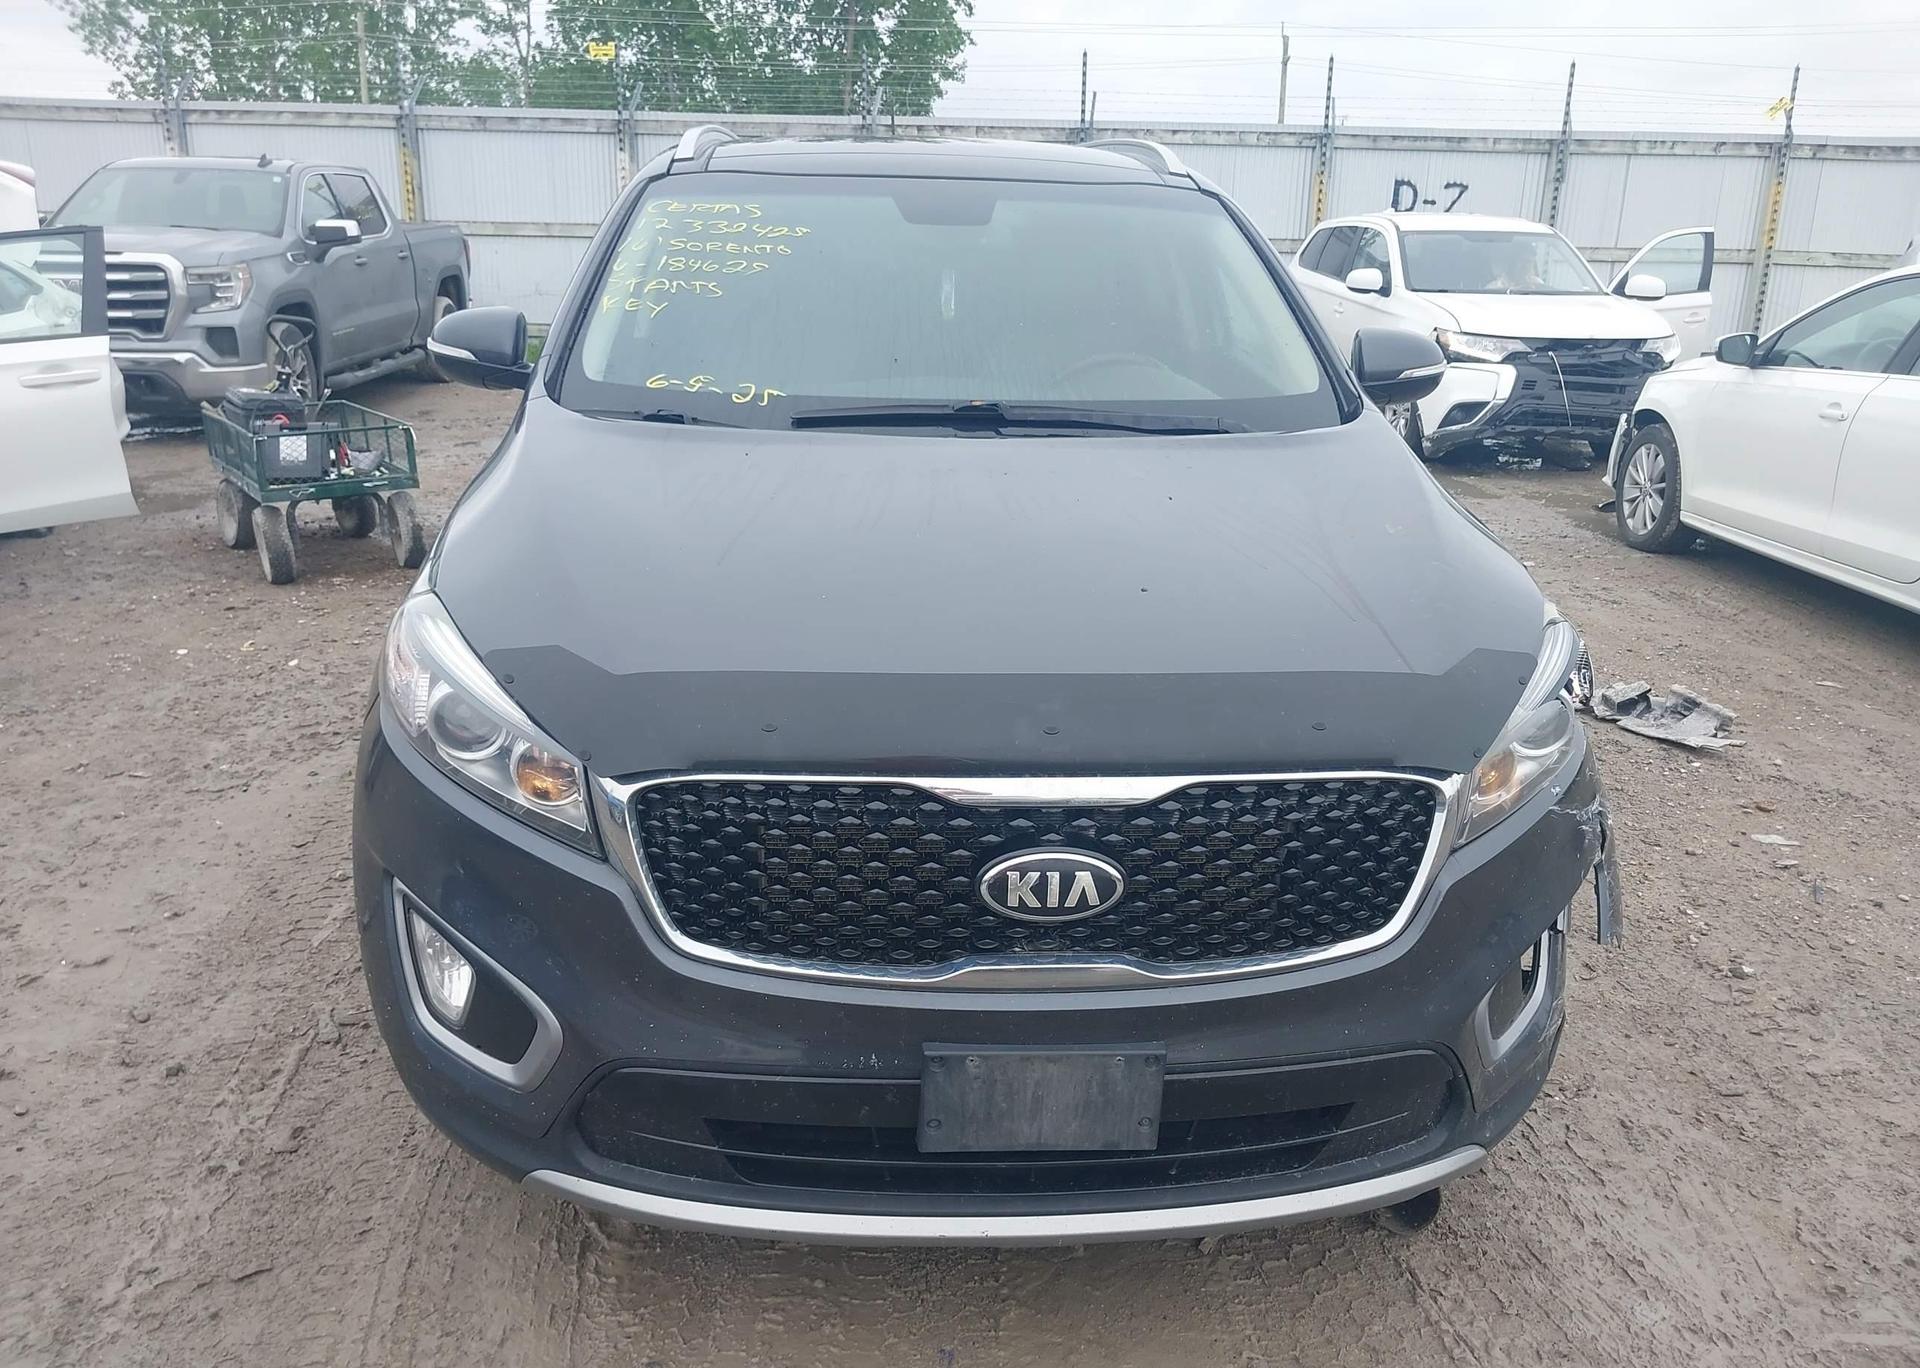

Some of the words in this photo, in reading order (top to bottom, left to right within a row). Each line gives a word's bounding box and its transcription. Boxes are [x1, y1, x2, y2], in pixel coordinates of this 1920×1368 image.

[1391, 179, 1469, 212] D-7
[602, 296, 668, 318] KEY
[1006, 871, 1100, 908] KIA
